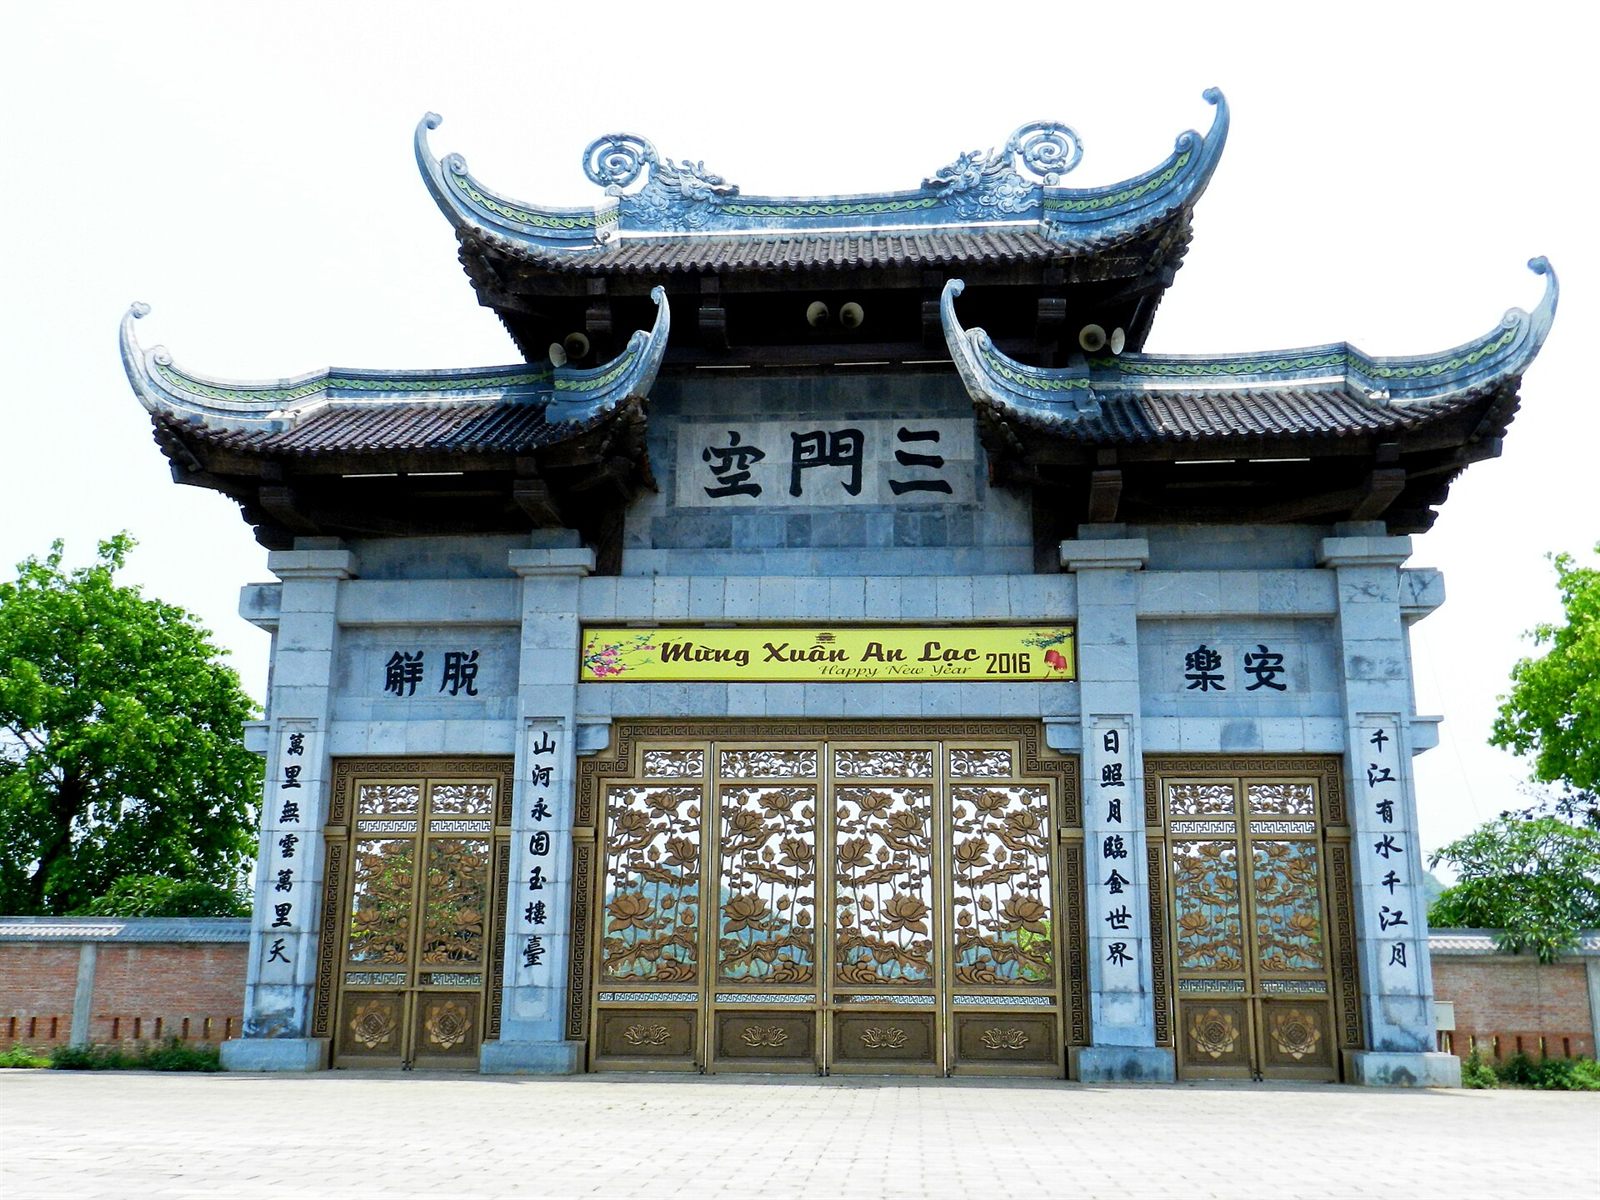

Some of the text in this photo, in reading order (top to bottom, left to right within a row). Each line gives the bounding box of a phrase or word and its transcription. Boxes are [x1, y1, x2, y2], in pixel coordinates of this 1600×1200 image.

[660, 641, 1031, 674] Mừng Xuân An Lạc 2016
[818, 663, 972, 678] Happy New Year
